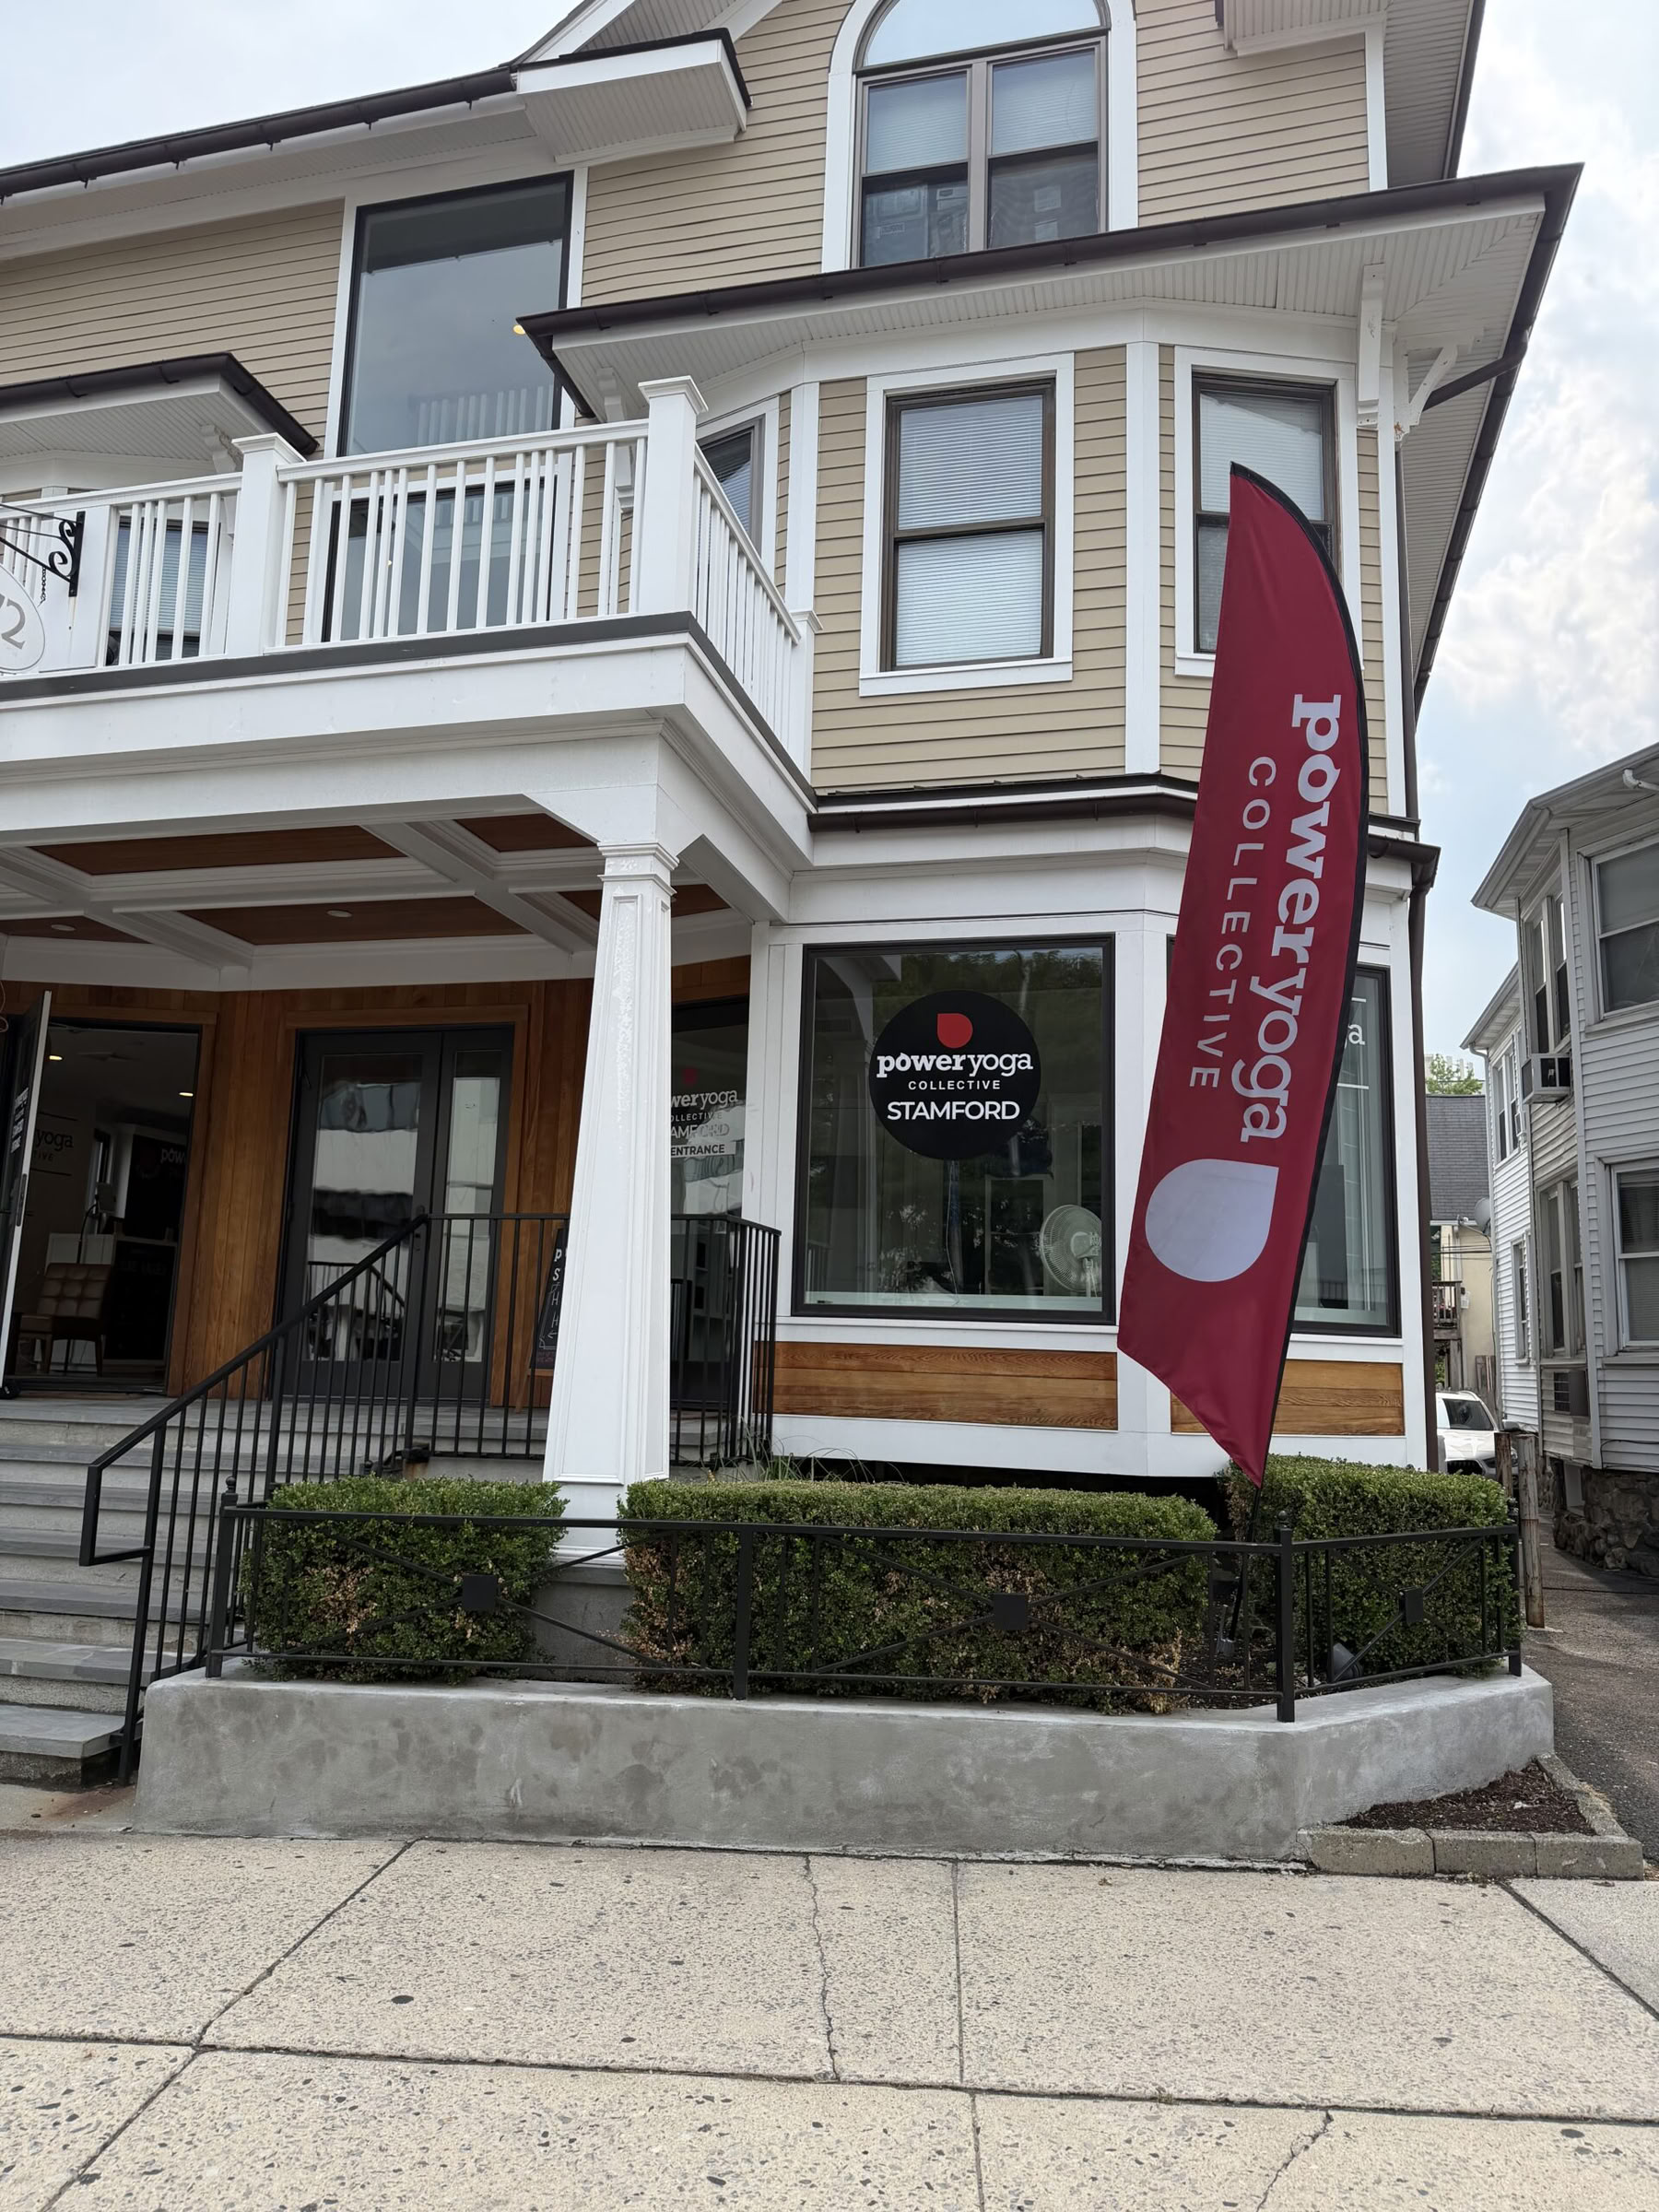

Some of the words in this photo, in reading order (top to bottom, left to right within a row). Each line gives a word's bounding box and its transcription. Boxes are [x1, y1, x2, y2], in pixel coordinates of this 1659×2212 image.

[0, 594, 26, 650] 2
[1189, 756, 1277, 1088] COLLECTIVE
[908, 1079, 1001, 1090] COLLECTIVE
[671, 1090, 737, 1110] weryoga
[671, 1112, 723, 1122] OLLECTIVE
[887, 1100, 1020, 1121] STAMFORD
[671, 1124, 730, 1138] AMFORD
[671, 1144, 725, 1156] ENTRANCE
